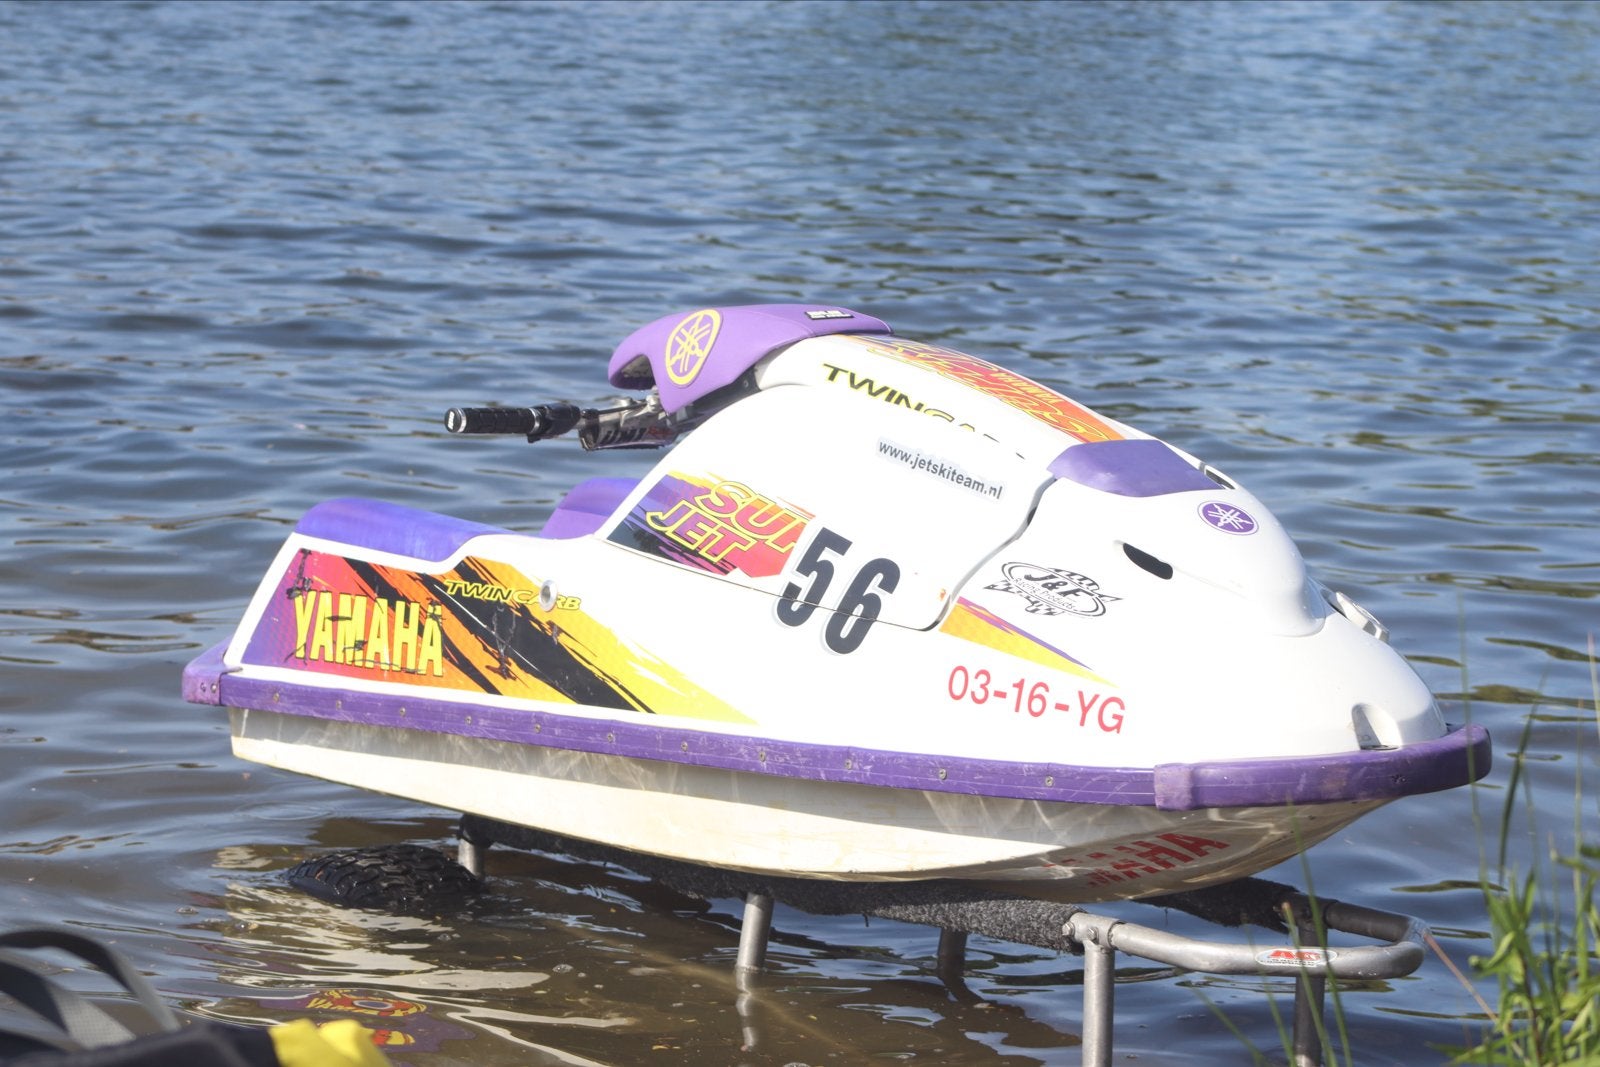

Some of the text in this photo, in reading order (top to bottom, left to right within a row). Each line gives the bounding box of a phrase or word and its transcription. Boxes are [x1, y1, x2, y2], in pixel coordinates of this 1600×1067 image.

[879, 441, 1003, 499] www.jetskiteam.nl
[645, 499, 758, 564] JET
[776, 526, 901, 655] 56
[1023, 573, 1095, 598] J&F
[294, 590, 444, 678] YAMAHA
[948, 665, 1126, 734] 03-16-YG
